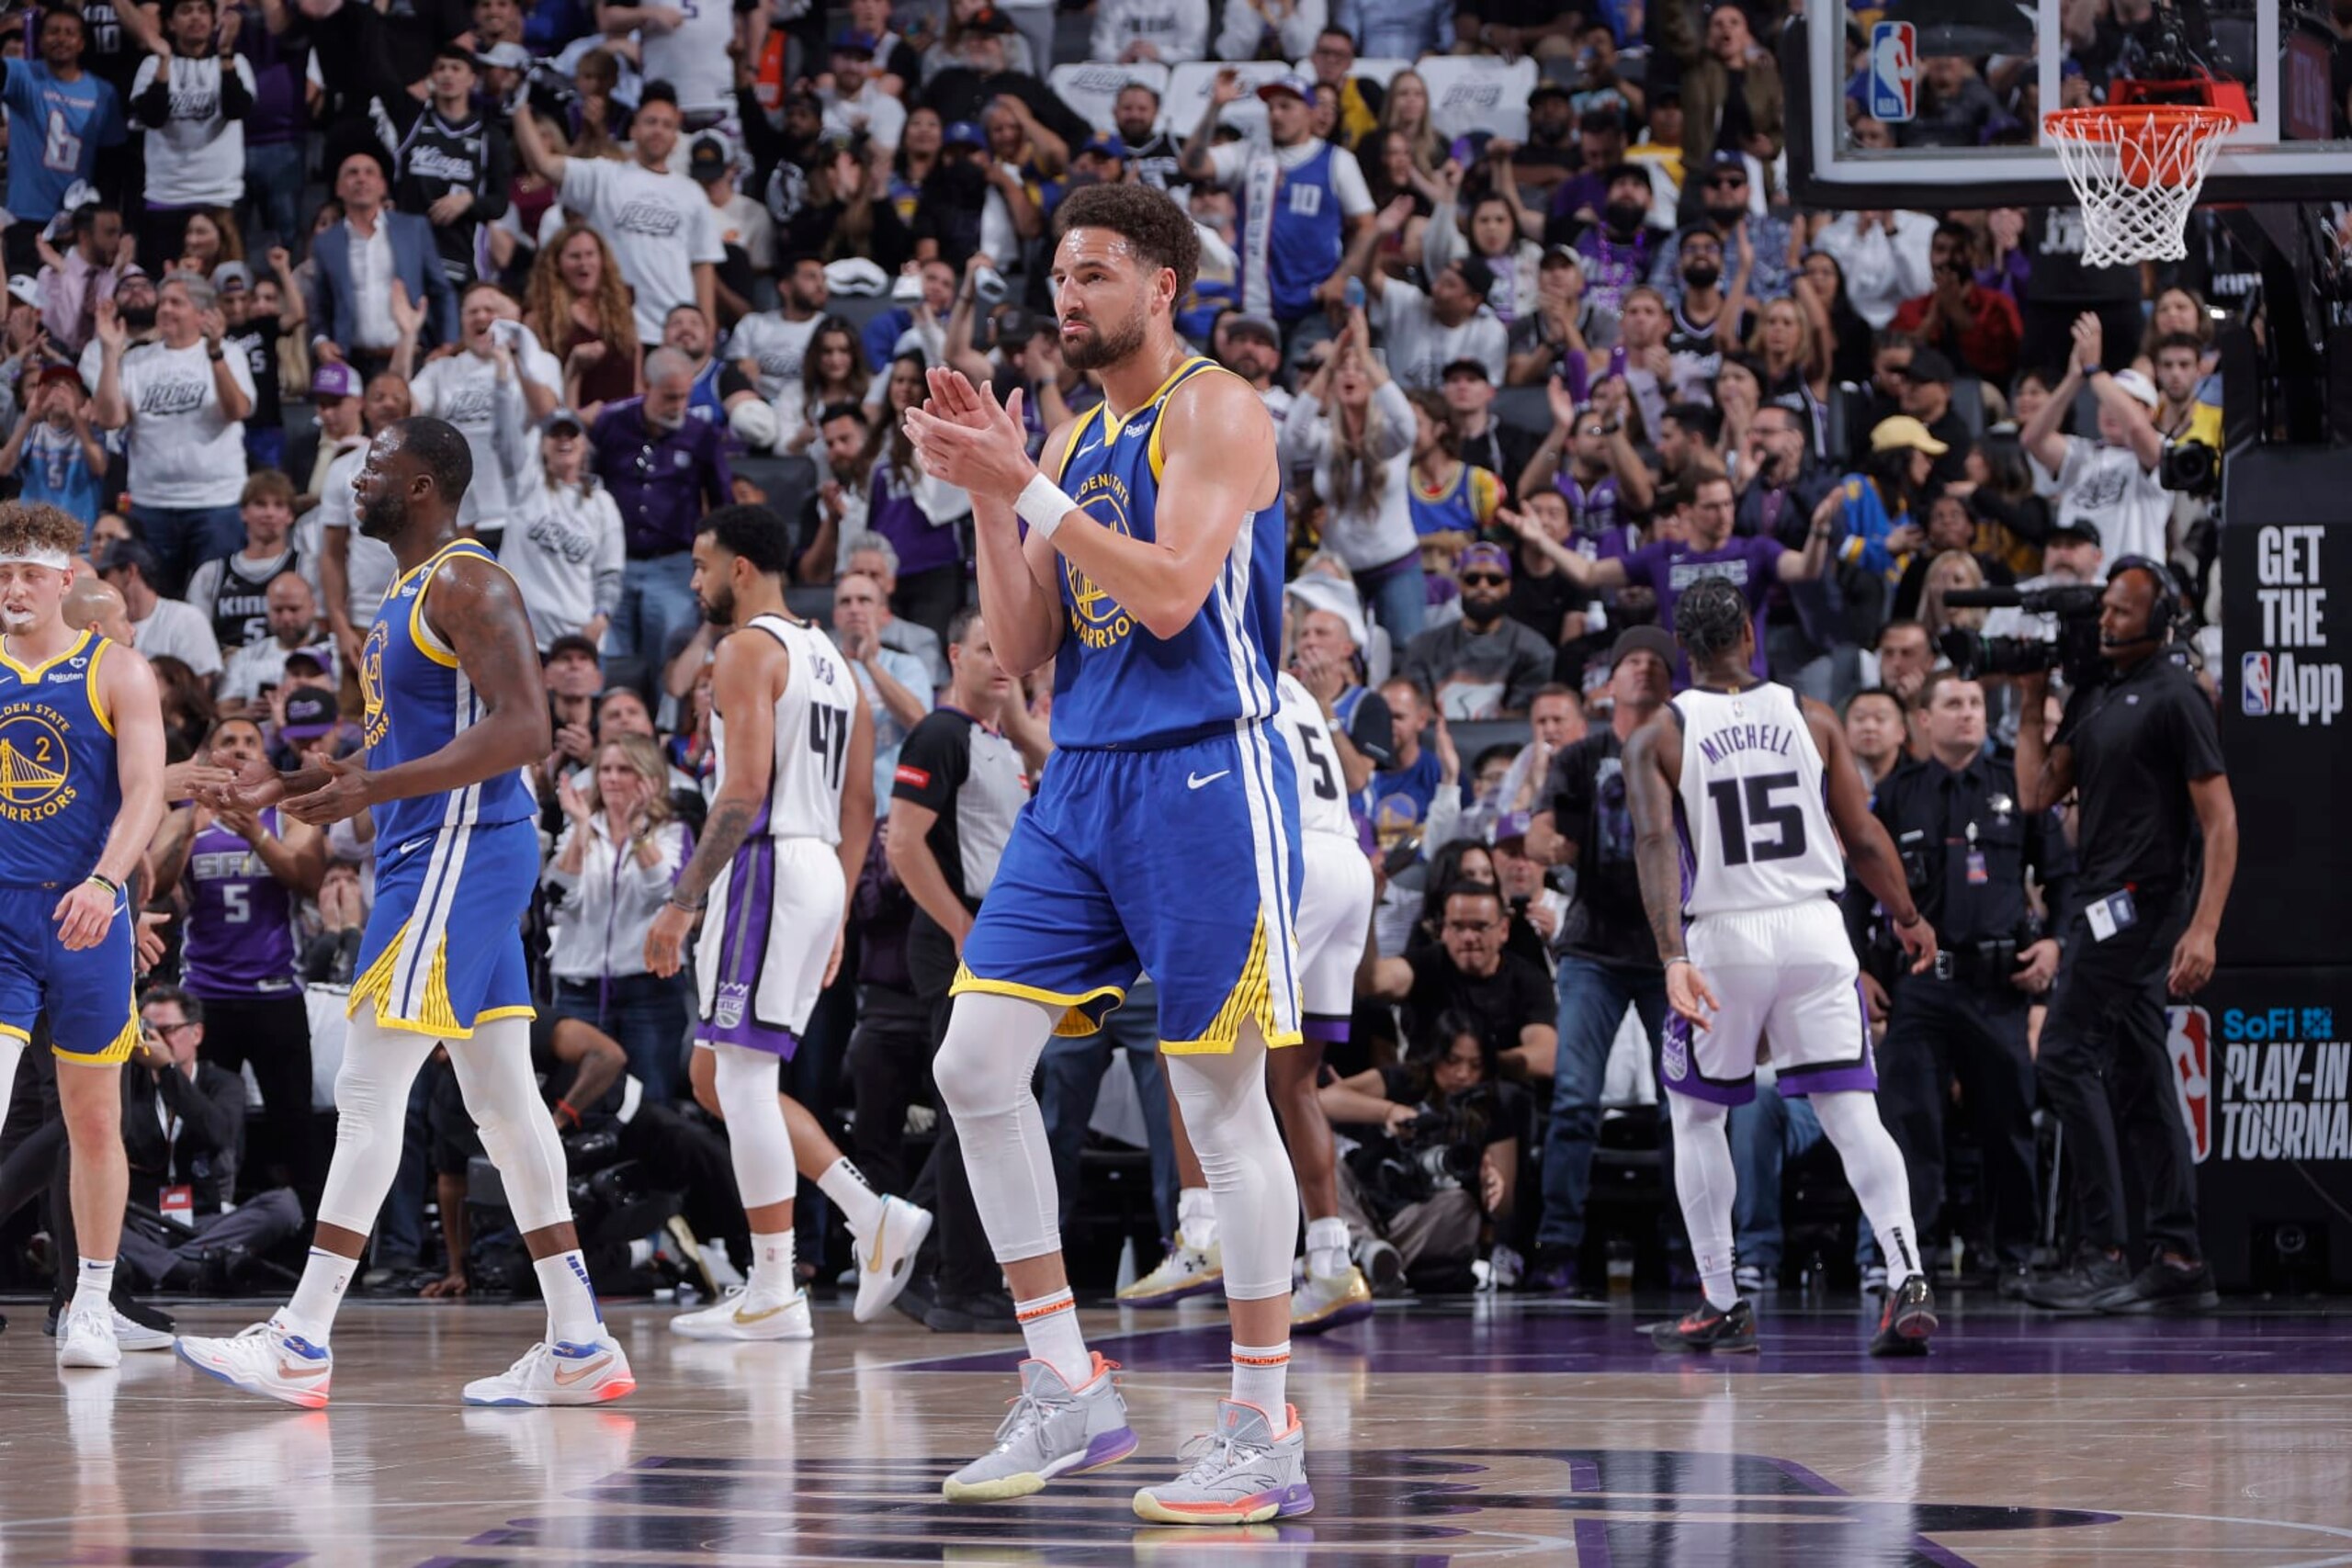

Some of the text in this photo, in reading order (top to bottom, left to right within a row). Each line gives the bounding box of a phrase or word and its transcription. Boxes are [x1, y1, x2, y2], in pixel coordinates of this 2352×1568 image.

[2257, 525, 2326, 585] GET
[1071, 604, 1139, 649] WARRIO
[2256, 588, 2327, 647] THE
[48, 671, 85, 683] Rakuten
[2274, 651, 2344, 726] App
[35, 704, 71, 733] STATE
[809, 701, 848, 791] 41
[1699, 723, 1793, 765] MITCHELL
[36, 736, 51, 762] 2
[1296, 721, 1339, 801] 5
[1707, 771, 1807, 866] 15
[223, 884, 250, 923] 5
[2222, 1008, 2296, 1040] SoFi
[2222, 1042, 2352, 1100] PLAY-IN
[2221, 1101, 2352, 1160] TOURNA
